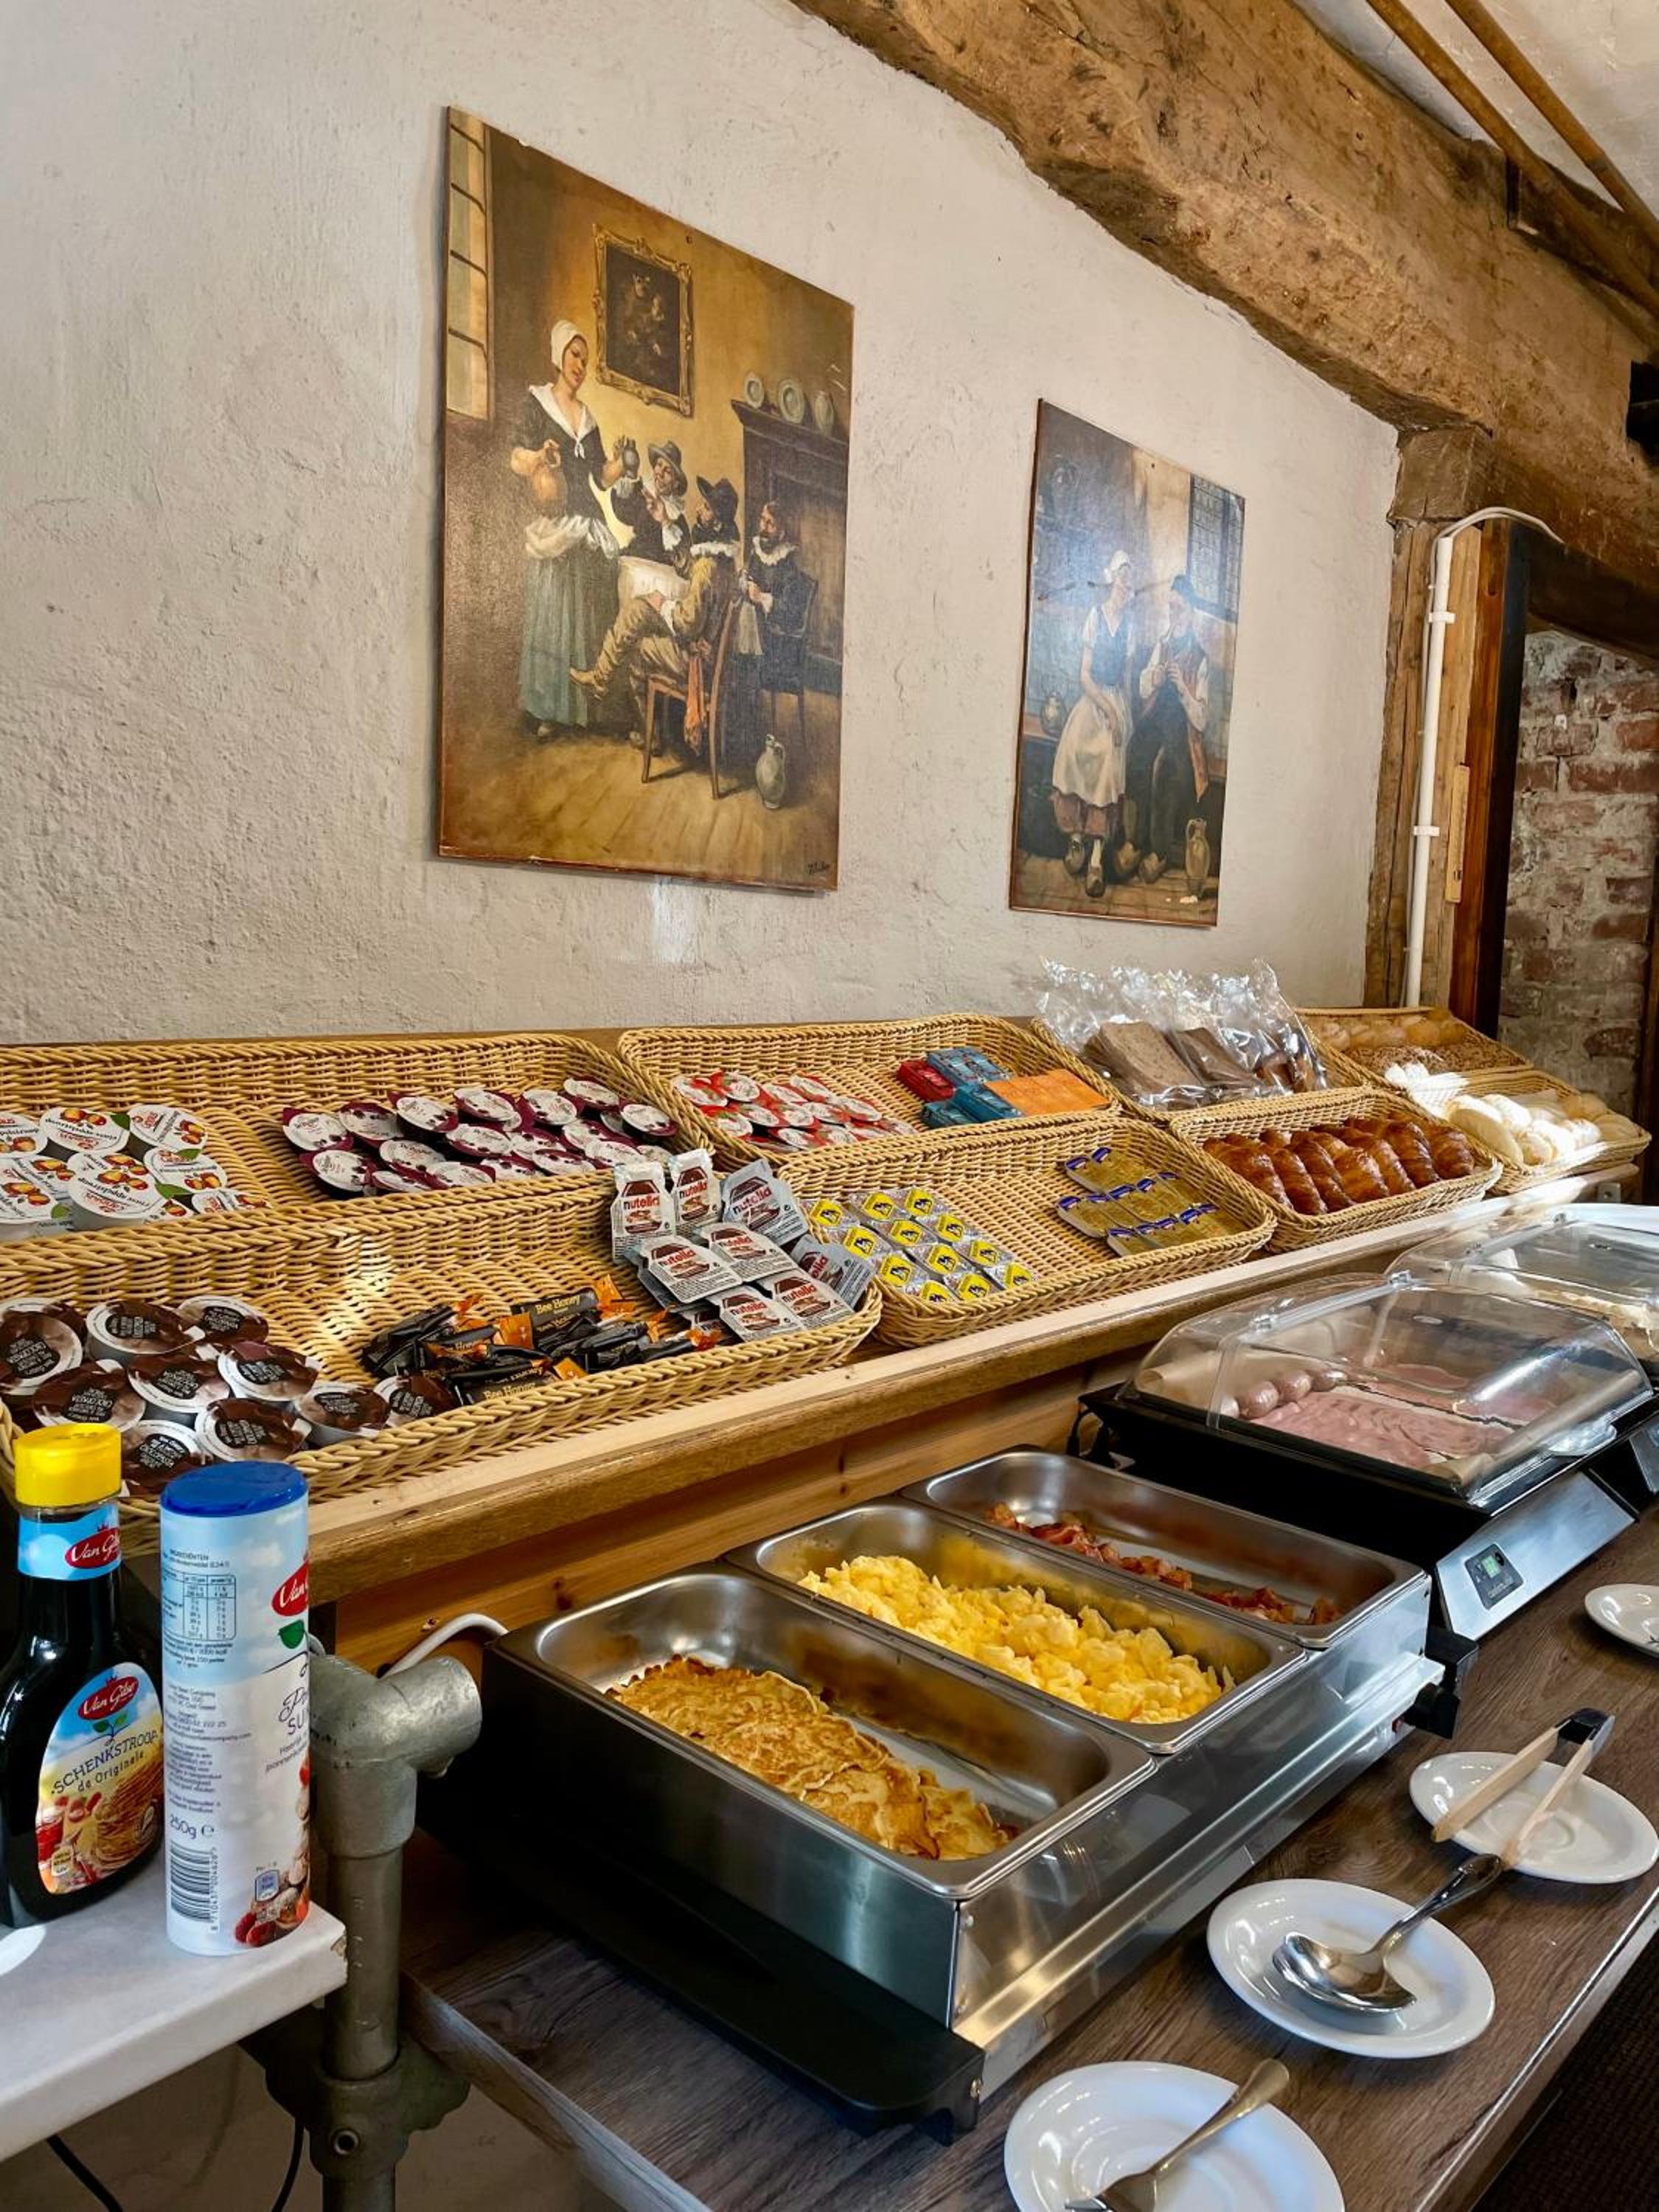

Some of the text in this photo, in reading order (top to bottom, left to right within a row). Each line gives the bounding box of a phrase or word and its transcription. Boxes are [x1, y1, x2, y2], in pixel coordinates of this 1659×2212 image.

[679, 1181, 708, 1198] nutella
[623, 1196, 660, 1210] nutella
[732, 1186, 772, 1215] nutella
[718, 1237, 754, 1247] nutella
[658, 1249, 697, 1267] nutella
[782, 1284, 817, 1303] nutella
[535, 1303, 553, 1315] Bee
[552, 1294, 580, 1309] Honey
[731, 1302, 767, 1315] nutella
[71, 1543, 100, 1562] Van
[280, 1579, 305, 1608] Van
[83, 1696, 108, 1715] Van
[51, 1730, 159, 1794] SCHENKSTROOP
[77, 1779, 91, 1792] de
[170, 1814, 197, 1840] 250g
